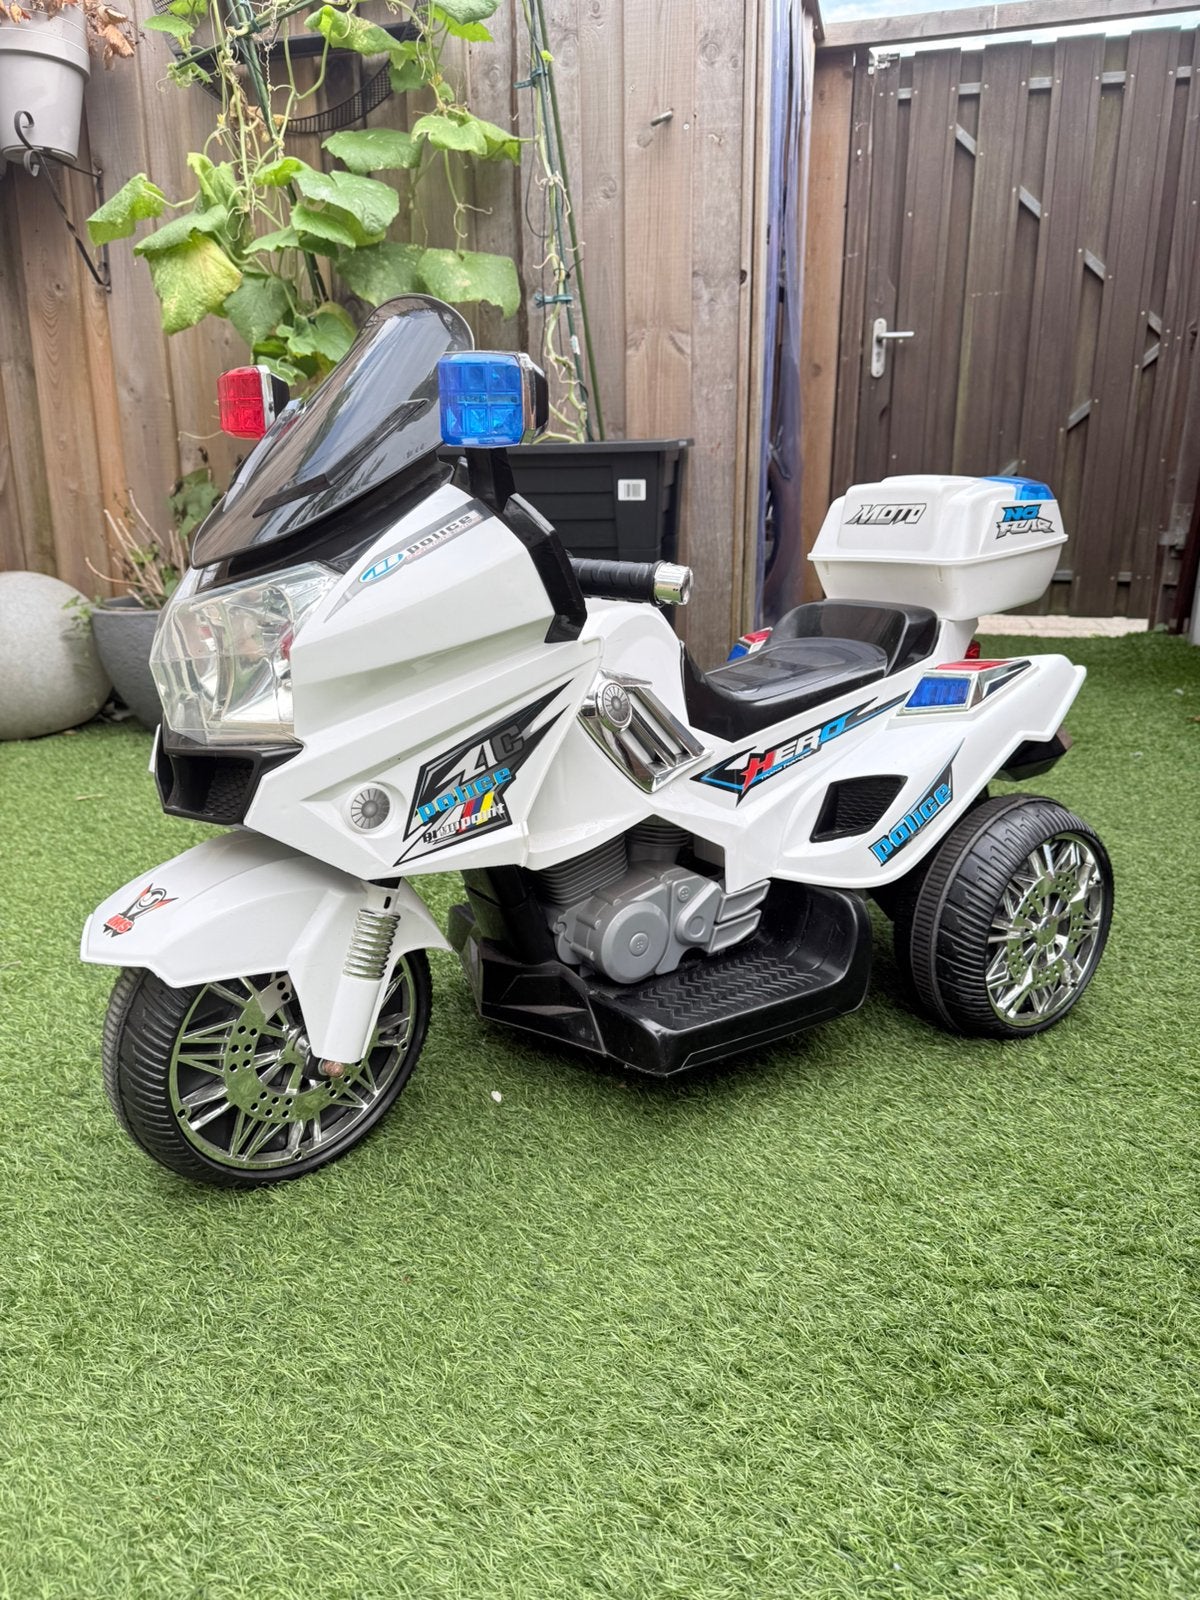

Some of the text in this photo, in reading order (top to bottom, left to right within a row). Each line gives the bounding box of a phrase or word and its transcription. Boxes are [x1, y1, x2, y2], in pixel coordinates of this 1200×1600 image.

[845, 503, 927, 525] MOTO
[996, 518, 1055, 539] FEAR
[1001, 504, 1041, 521] NO
[406, 515, 473, 554] police
[742, 714, 850, 788] HERO
[417, 767, 512, 824] police
[870, 782, 951, 865] police
